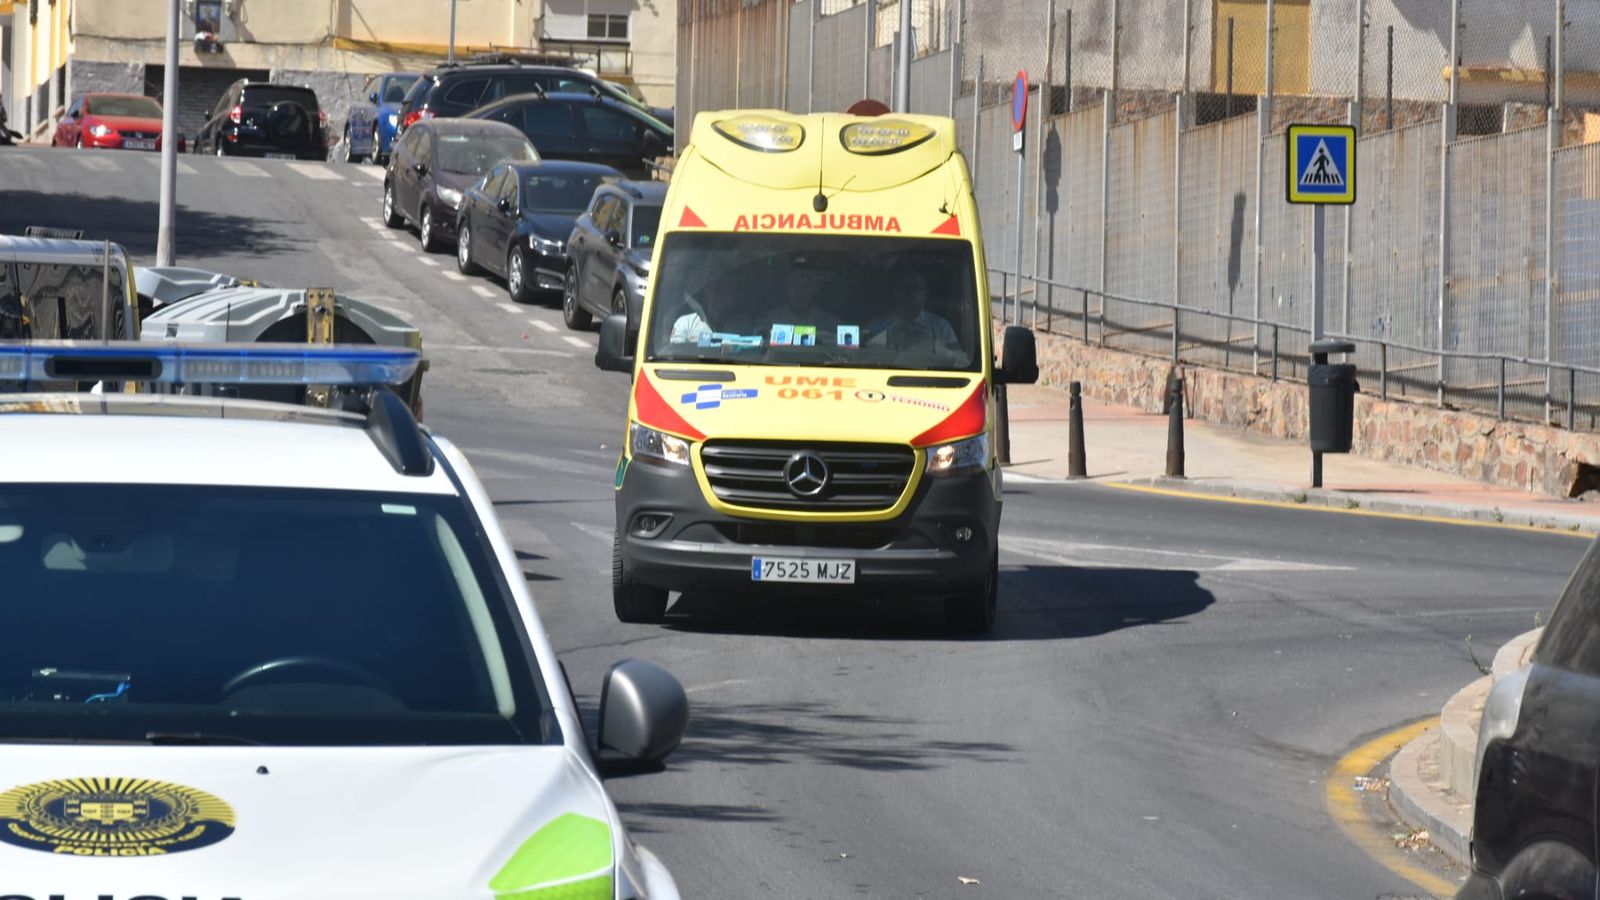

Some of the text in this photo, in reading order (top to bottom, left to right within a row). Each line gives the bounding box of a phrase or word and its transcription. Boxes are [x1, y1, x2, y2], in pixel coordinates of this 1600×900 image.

[764, 375, 857, 388] UME
[777, 388, 843, 401] 061
[765, 561, 852, 580] 7525 MJZ
